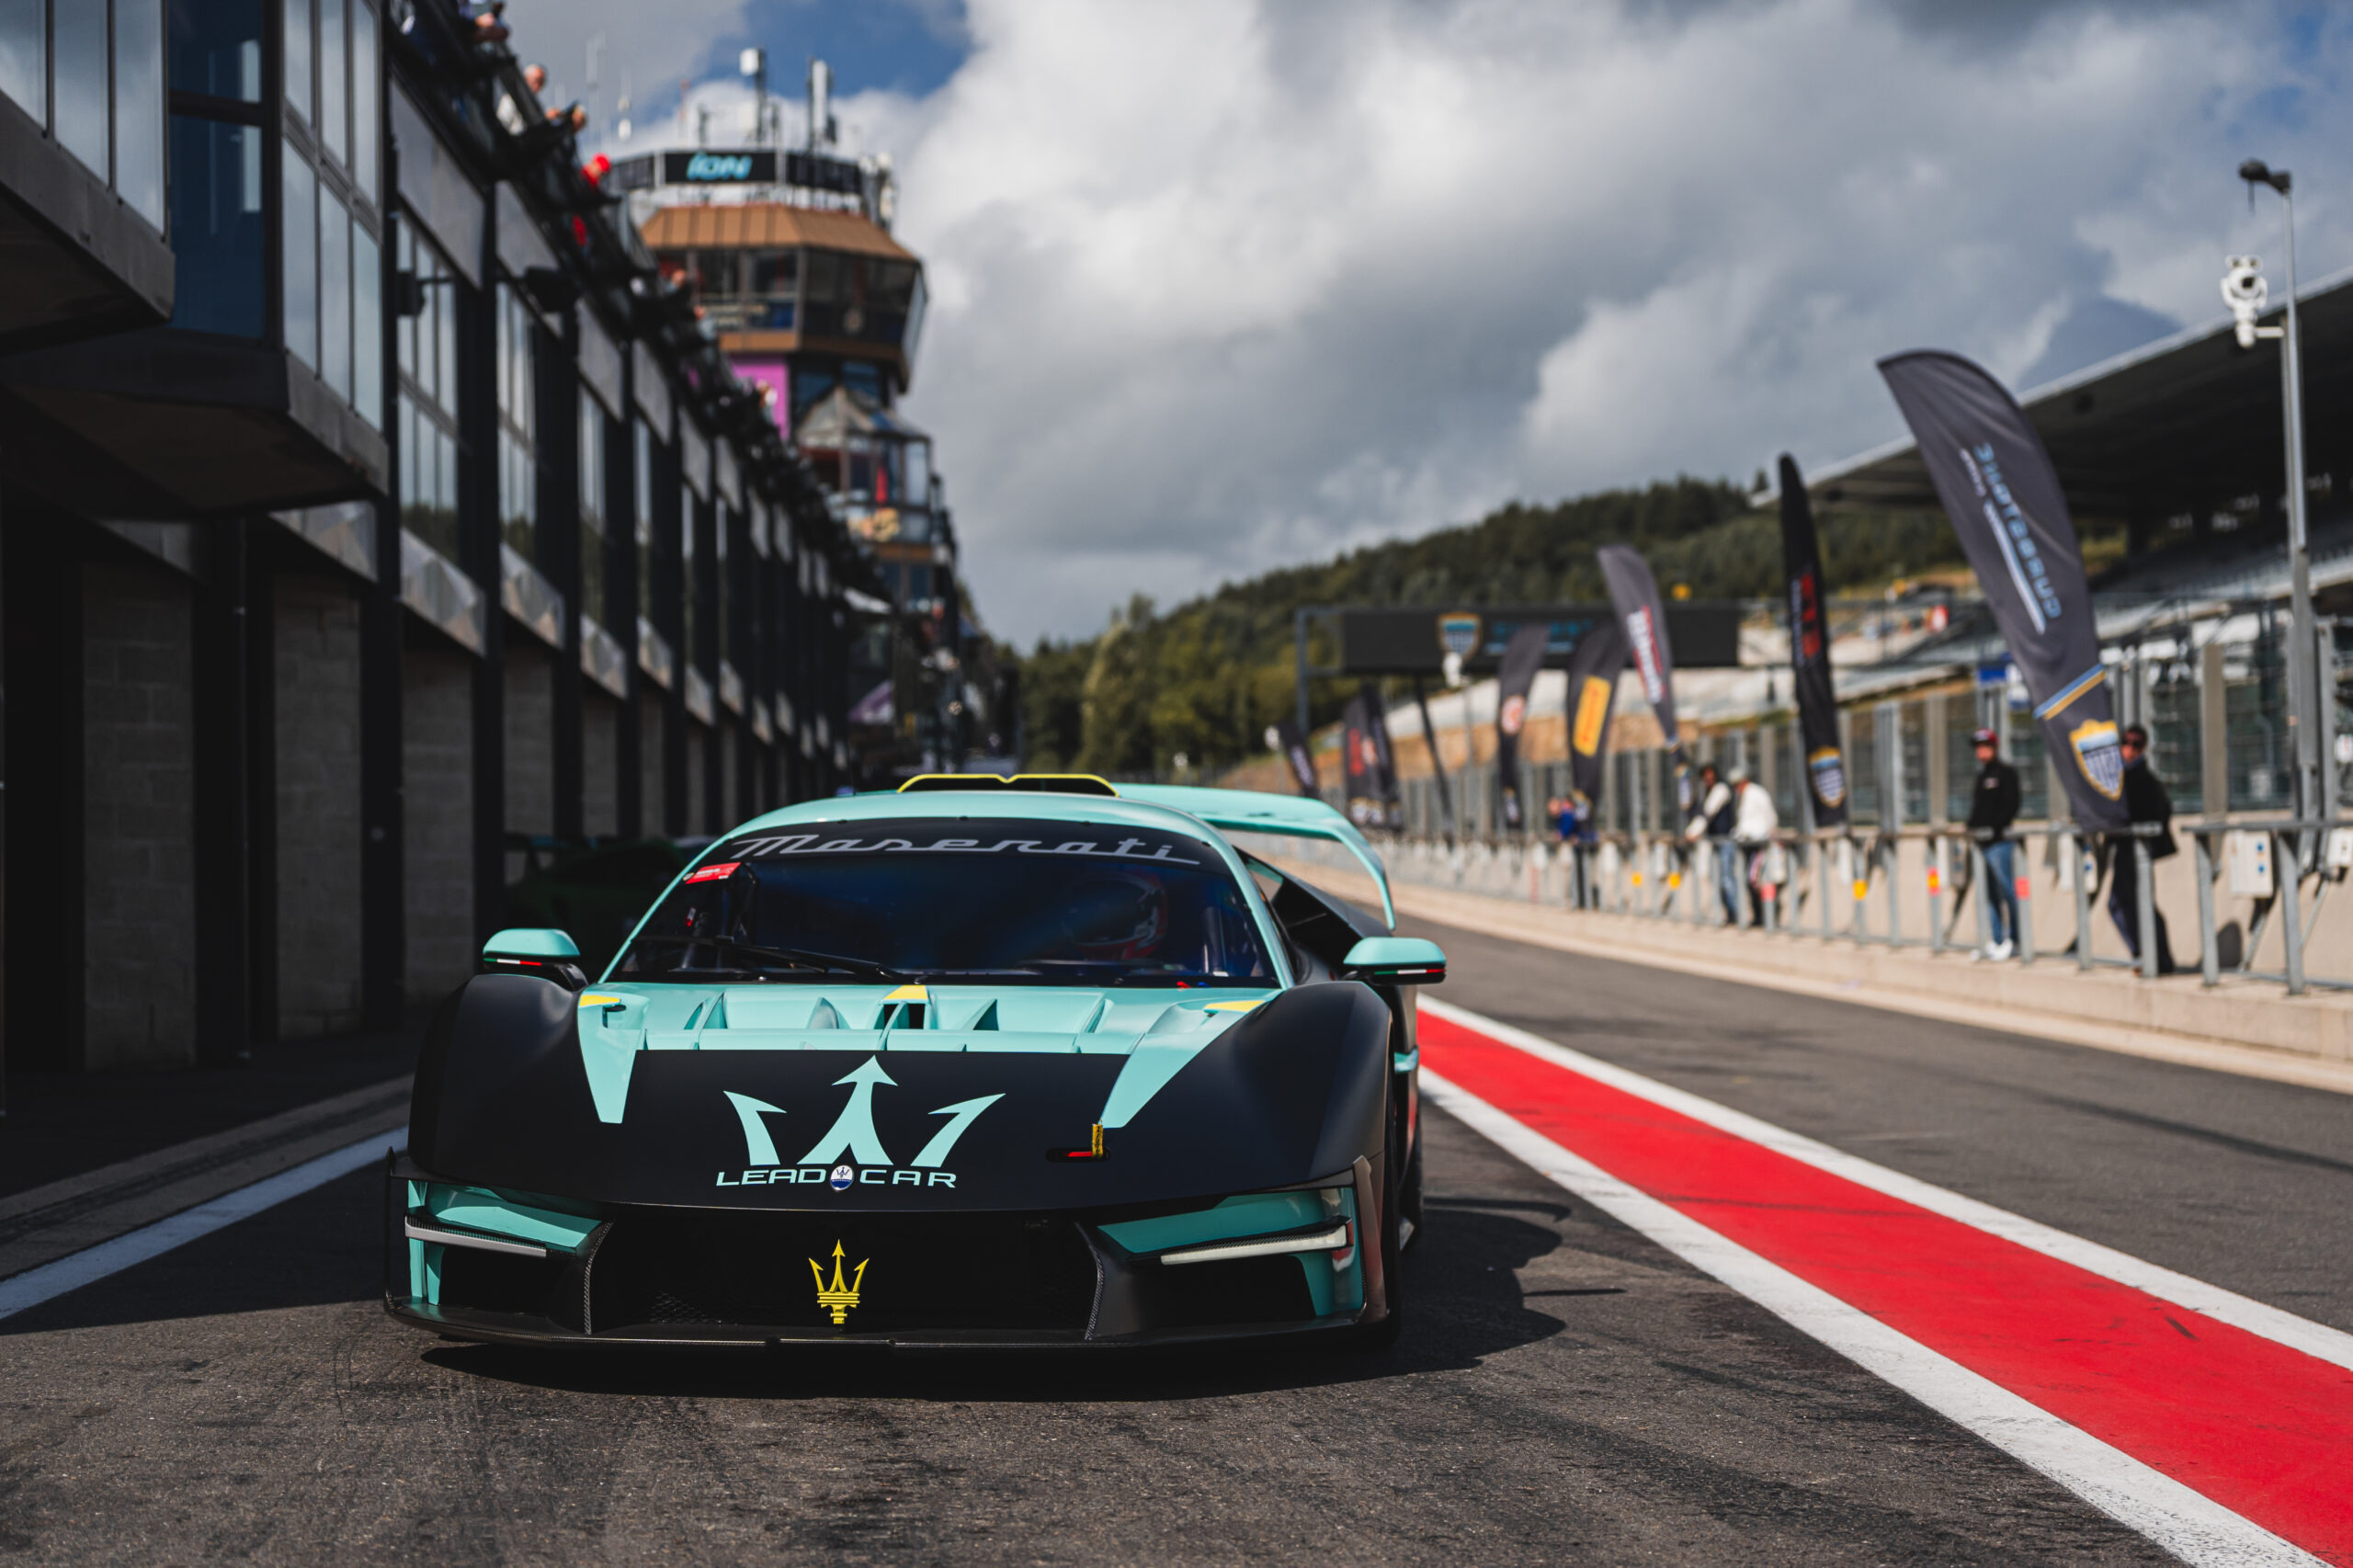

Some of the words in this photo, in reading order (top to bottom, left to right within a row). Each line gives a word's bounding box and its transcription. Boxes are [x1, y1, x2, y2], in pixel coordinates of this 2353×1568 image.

[730, 835, 1200, 865] Maserati
[716, 1168, 826, 1187] LEAD
[859, 1169, 957, 1188] CAR
